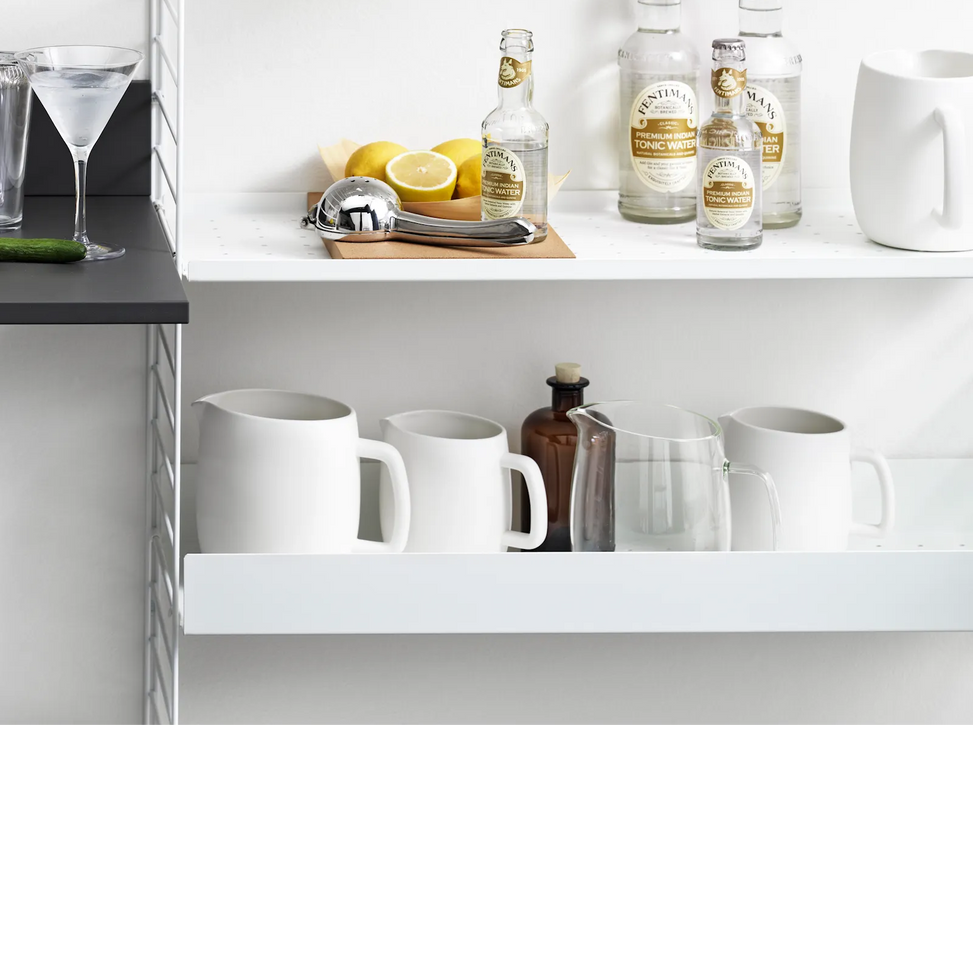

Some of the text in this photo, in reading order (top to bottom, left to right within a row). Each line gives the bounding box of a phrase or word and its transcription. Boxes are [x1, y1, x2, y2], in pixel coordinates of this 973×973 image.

[638, 88, 694, 116] FENTIMANS
[746, 90, 778, 120] MANS
[636, 130, 696, 140] PREMIUM INDIAN
[634, 138, 696, 150] TONIC WATER
[707, 160, 749, 180] FENTIMANS
[499, 182, 520, 190] INDIAN
[495, 188, 521, 197] WATER
[706, 189, 750, 197] PREMIUM INDIAN
[705, 195, 752, 205] TONIC WATER
